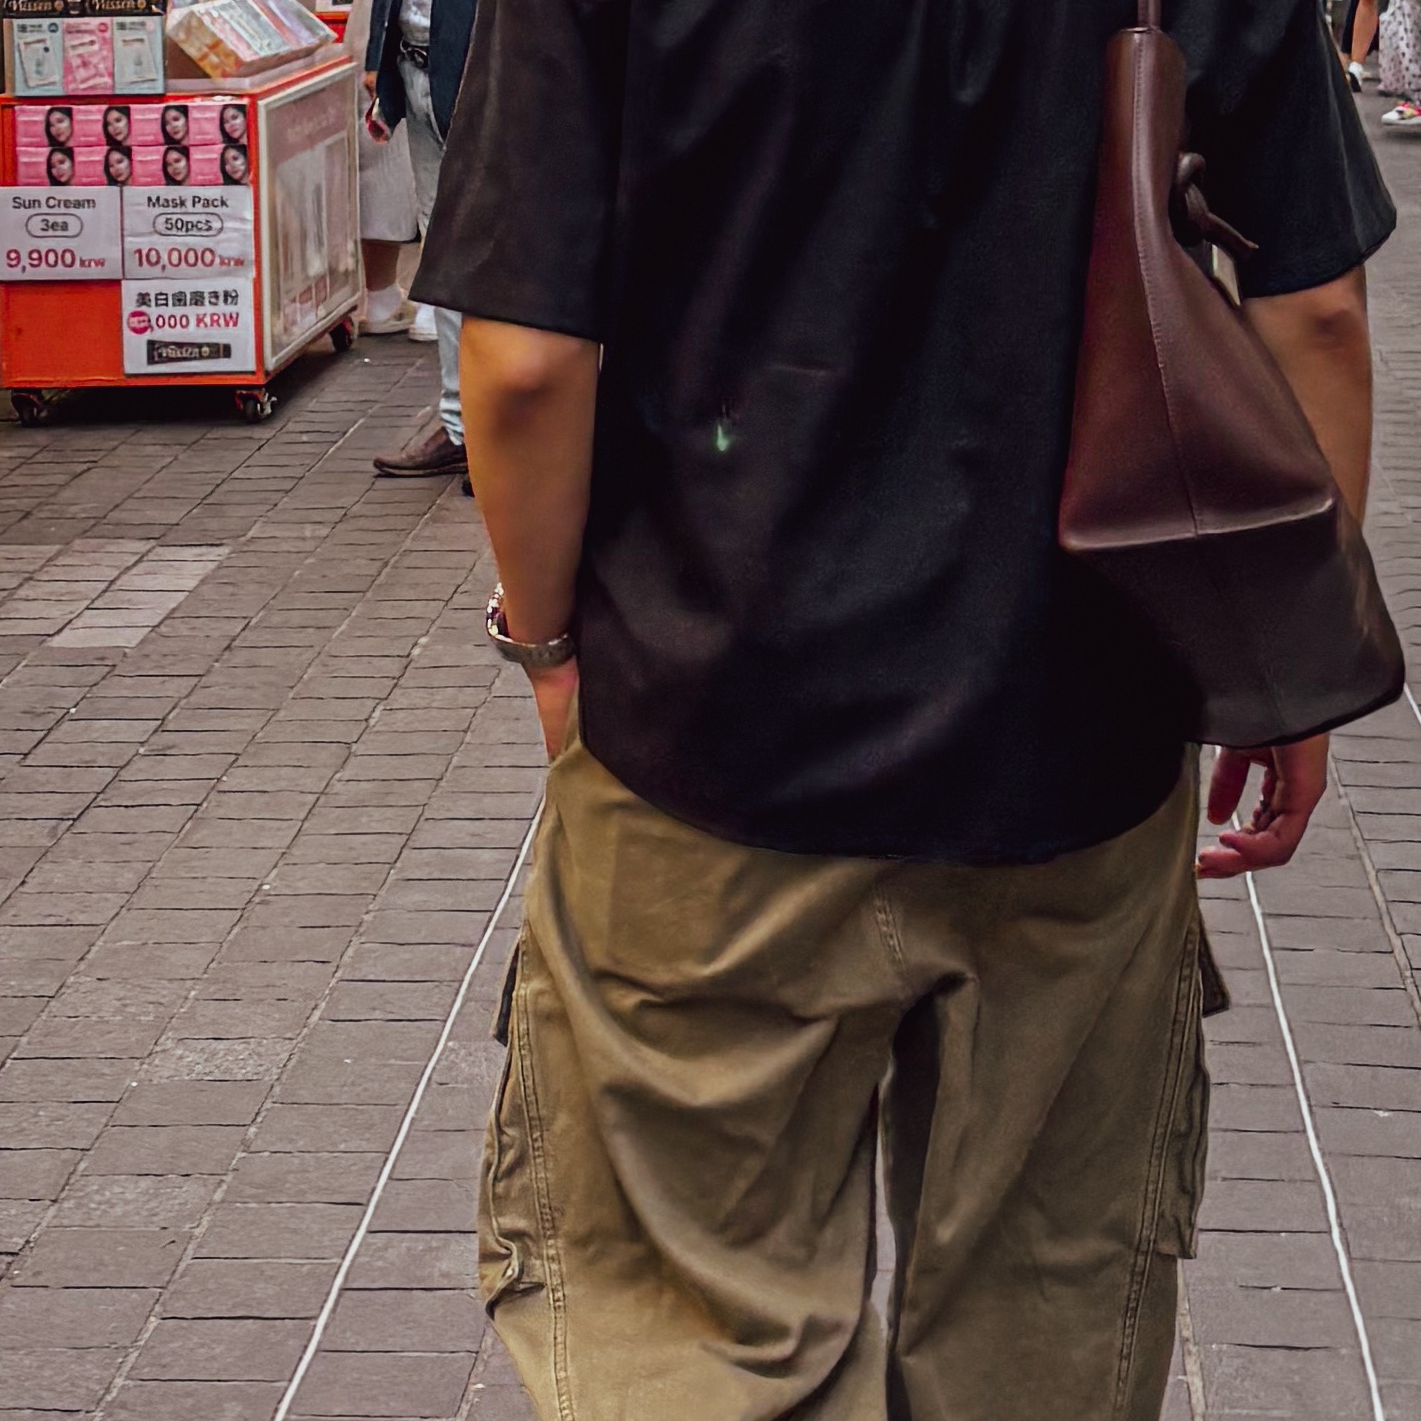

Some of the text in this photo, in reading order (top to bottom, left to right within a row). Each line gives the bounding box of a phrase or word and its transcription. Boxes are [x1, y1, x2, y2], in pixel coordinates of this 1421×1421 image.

[12, 196, 96, 210] Sun Cream
[147, 195, 229, 209] Mask Pack
[40, 218, 69, 232] 3ea
[164, 217, 213, 236] 50pcs
[5, 248, 106, 273] 9,900 krw
[134, 247, 245, 272] 10,000 krw
[195, 313, 239, 328] KRW
